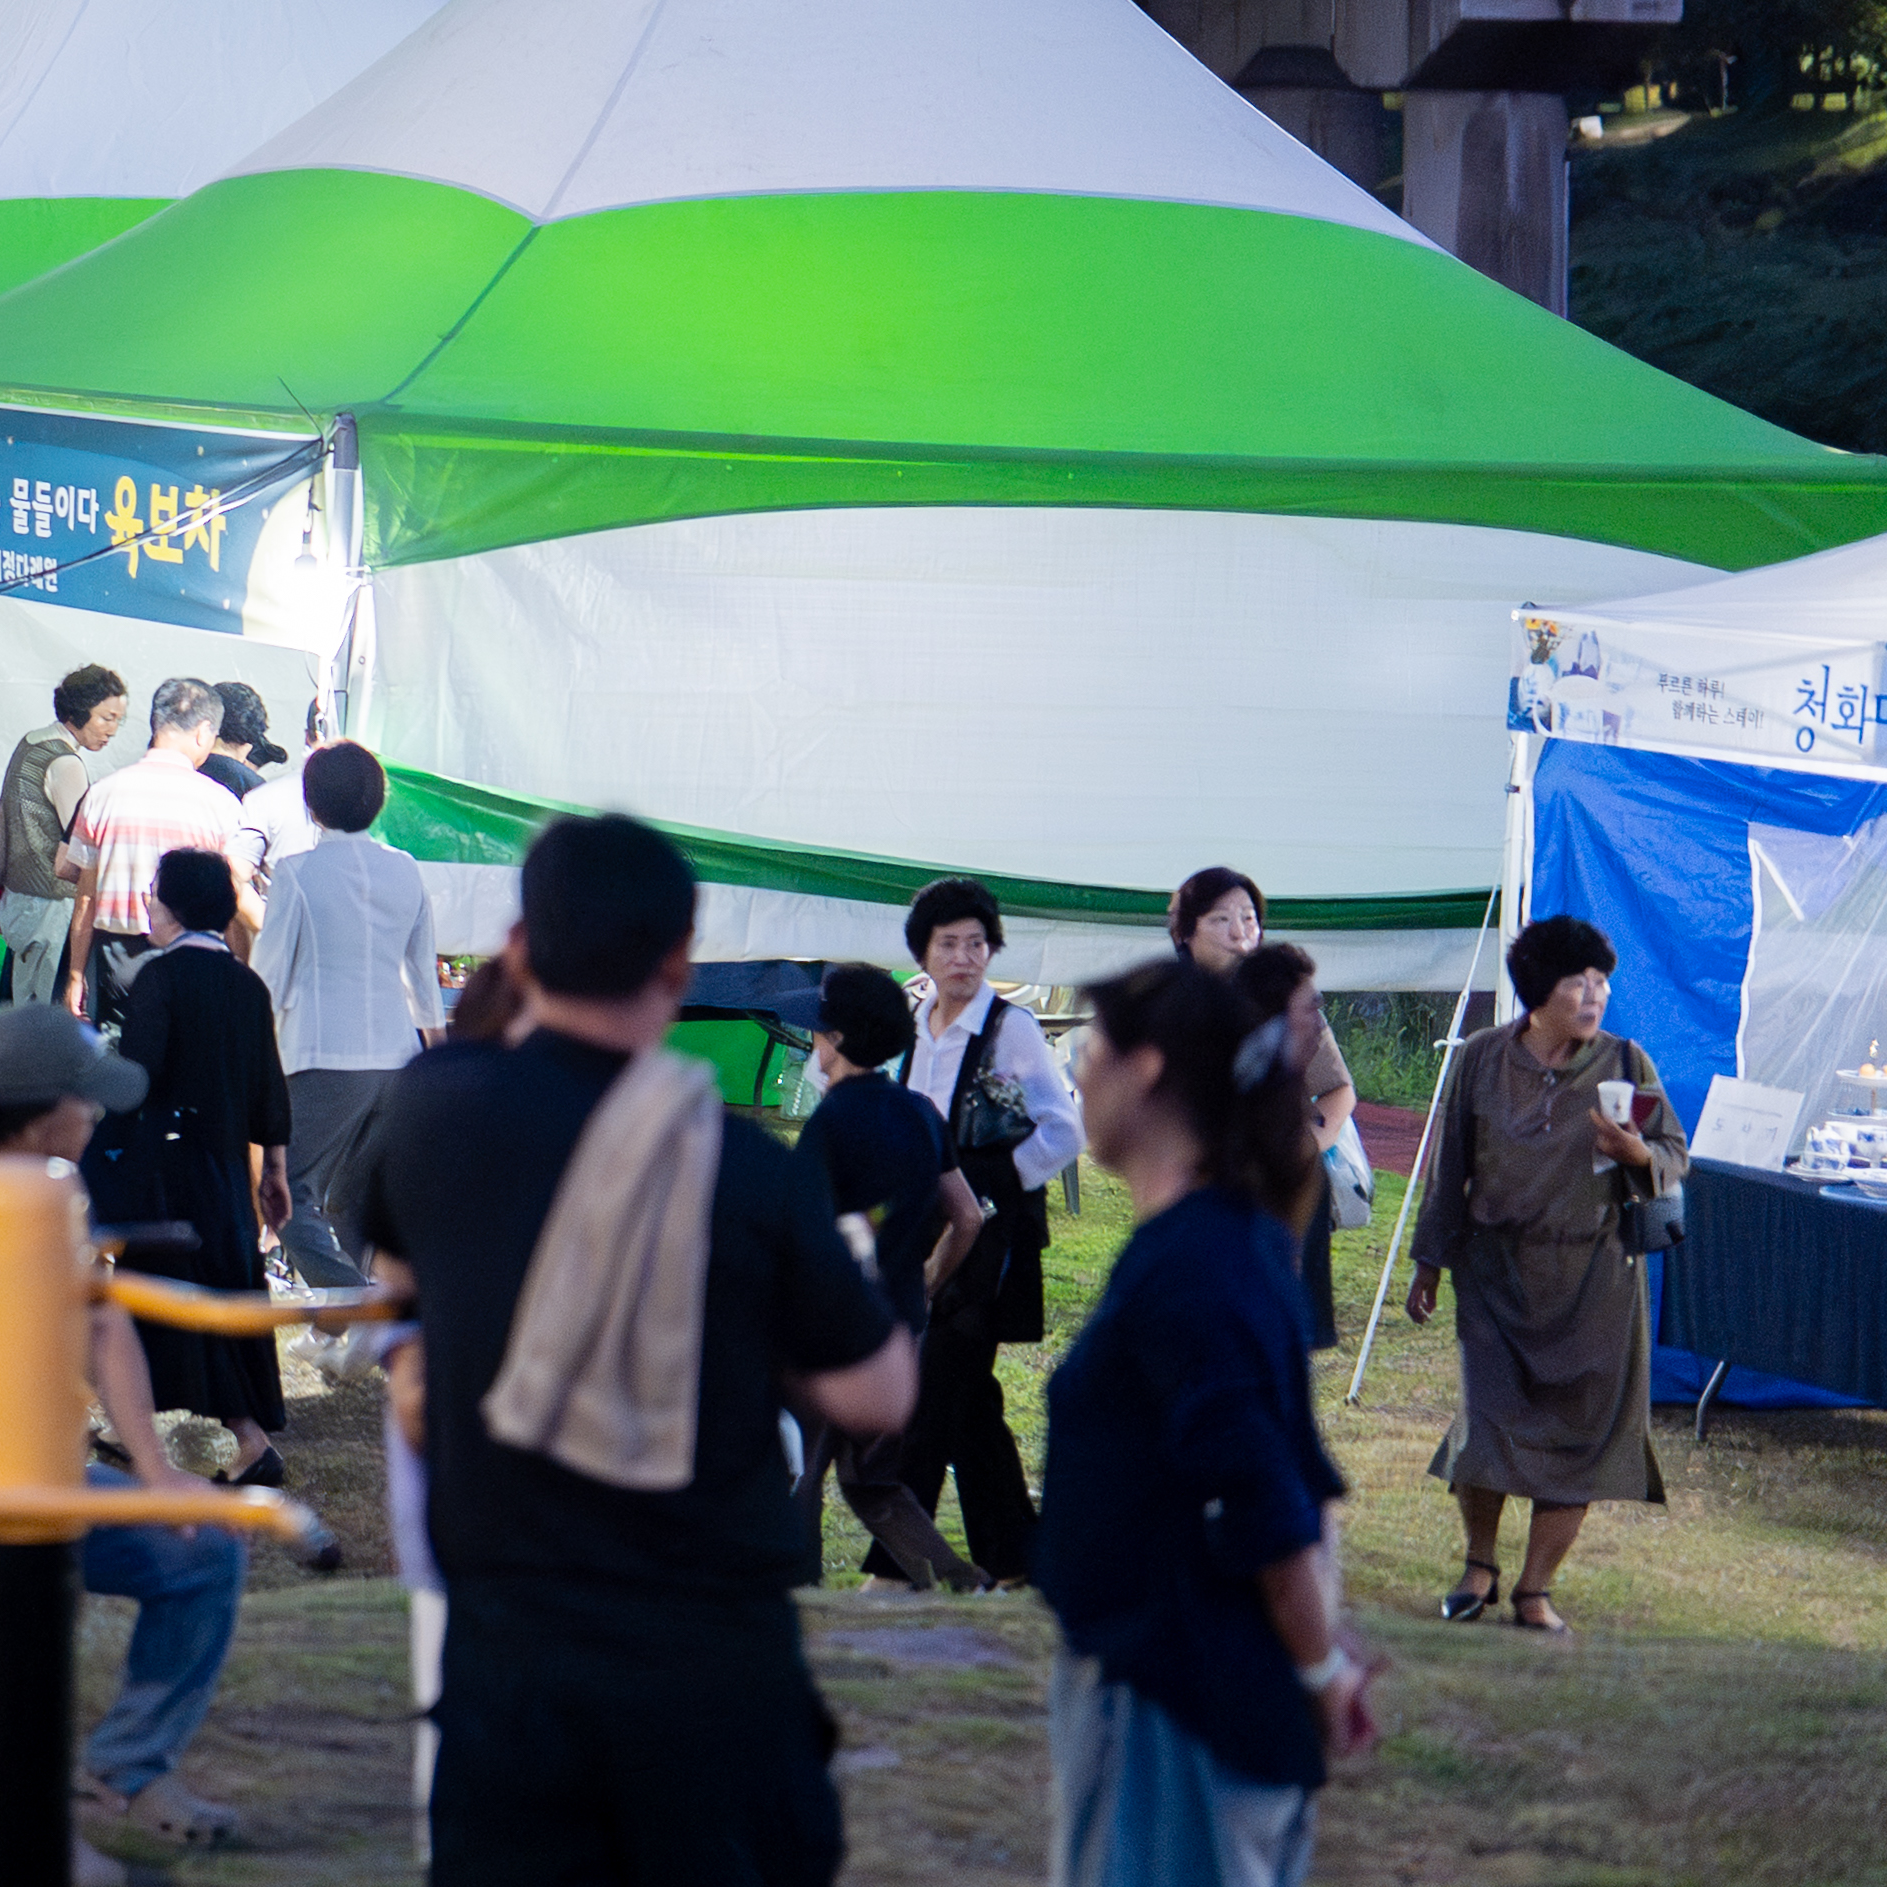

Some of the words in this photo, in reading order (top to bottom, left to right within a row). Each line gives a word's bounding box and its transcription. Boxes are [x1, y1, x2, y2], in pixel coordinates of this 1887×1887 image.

[9, 478, 99, 539] 물들이다
[105, 475, 226, 578] 육보차
[1658, 673, 1692, 695] 푸르른
